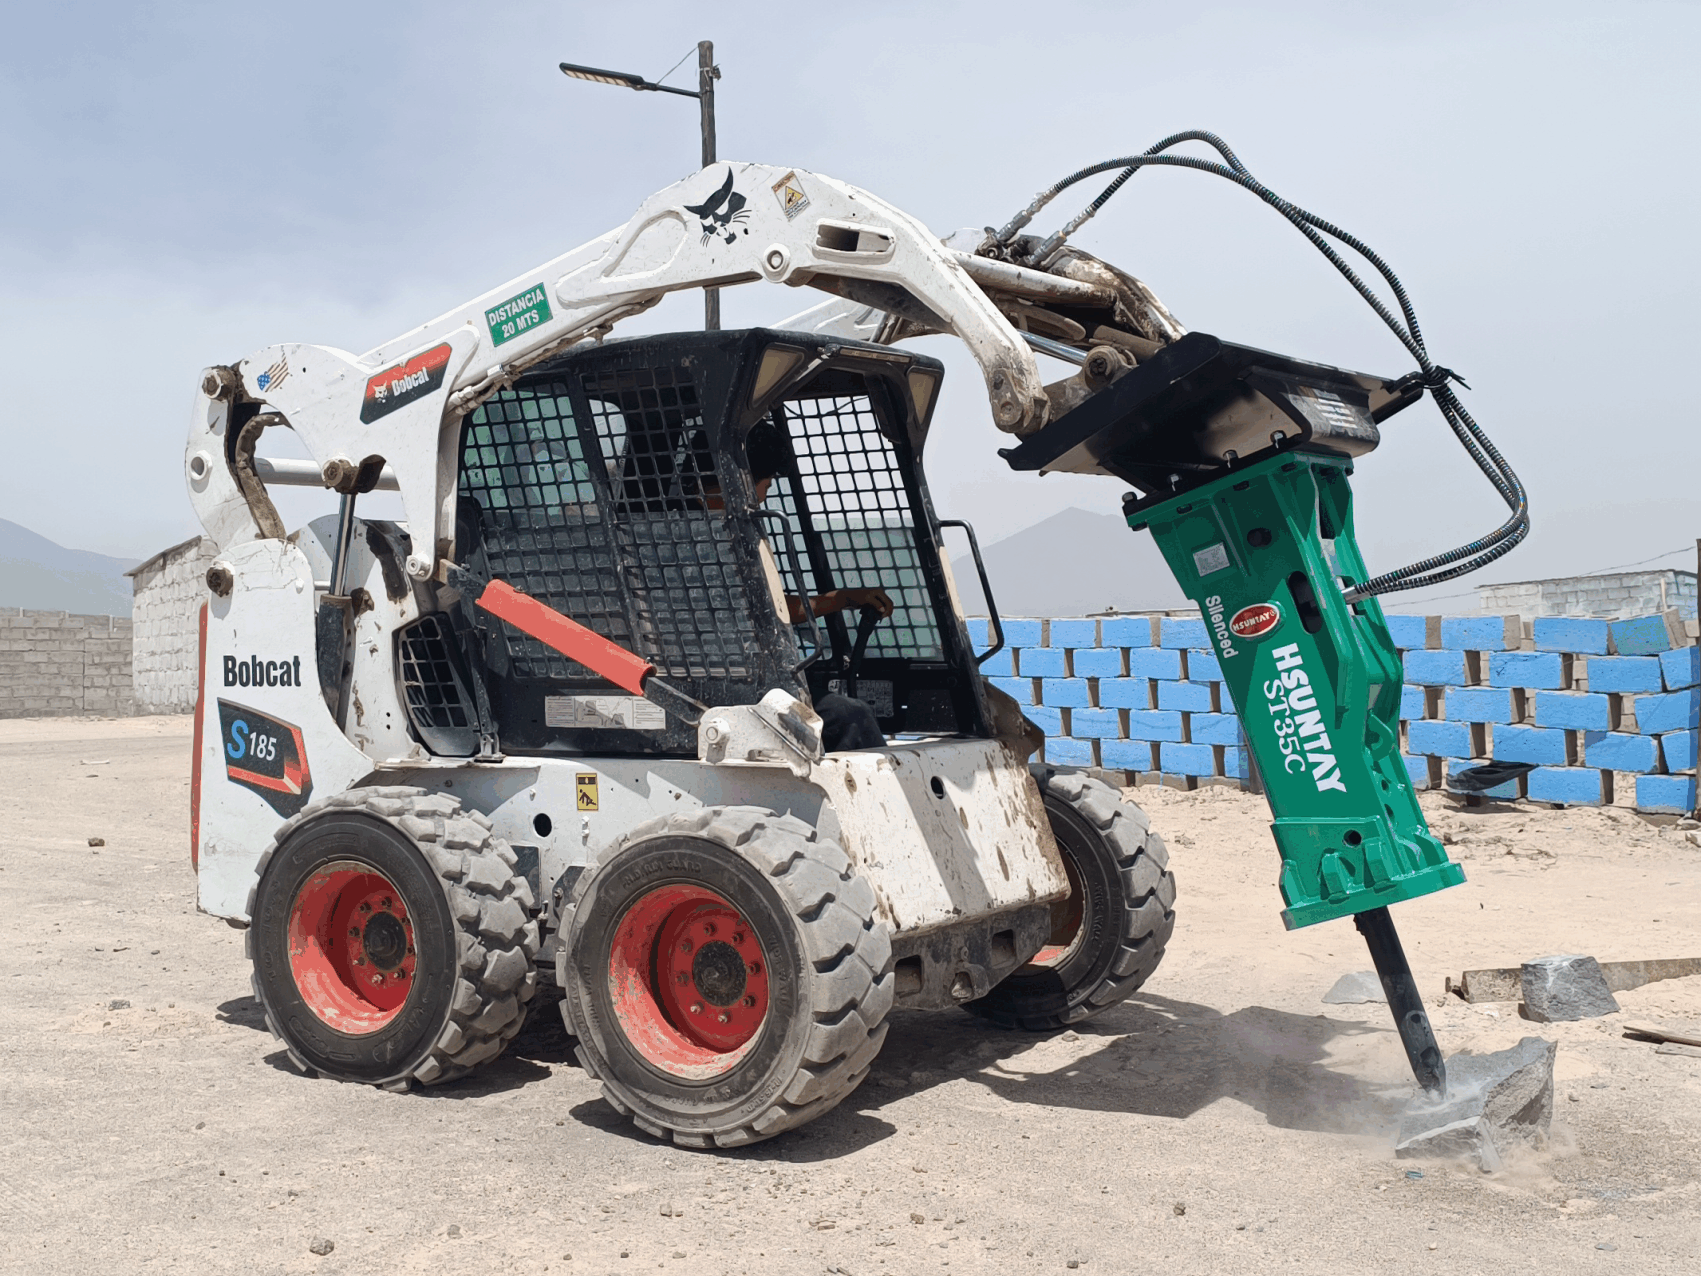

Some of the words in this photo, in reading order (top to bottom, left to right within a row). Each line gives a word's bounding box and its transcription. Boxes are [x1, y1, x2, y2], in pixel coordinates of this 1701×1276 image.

[488, 288, 544, 326] DISTANCIA
[502, 321, 515, 338] 20
[516, 309, 539, 331] MTS
[391, 367, 429, 396] Bobcat
[1205, 595, 1239, 658] Silenced
[223, 655, 302, 687] Bobcat
[1263, 678, 1306, 774] ST35C
[1272, 642, 1347, 793] HSUNTAY
